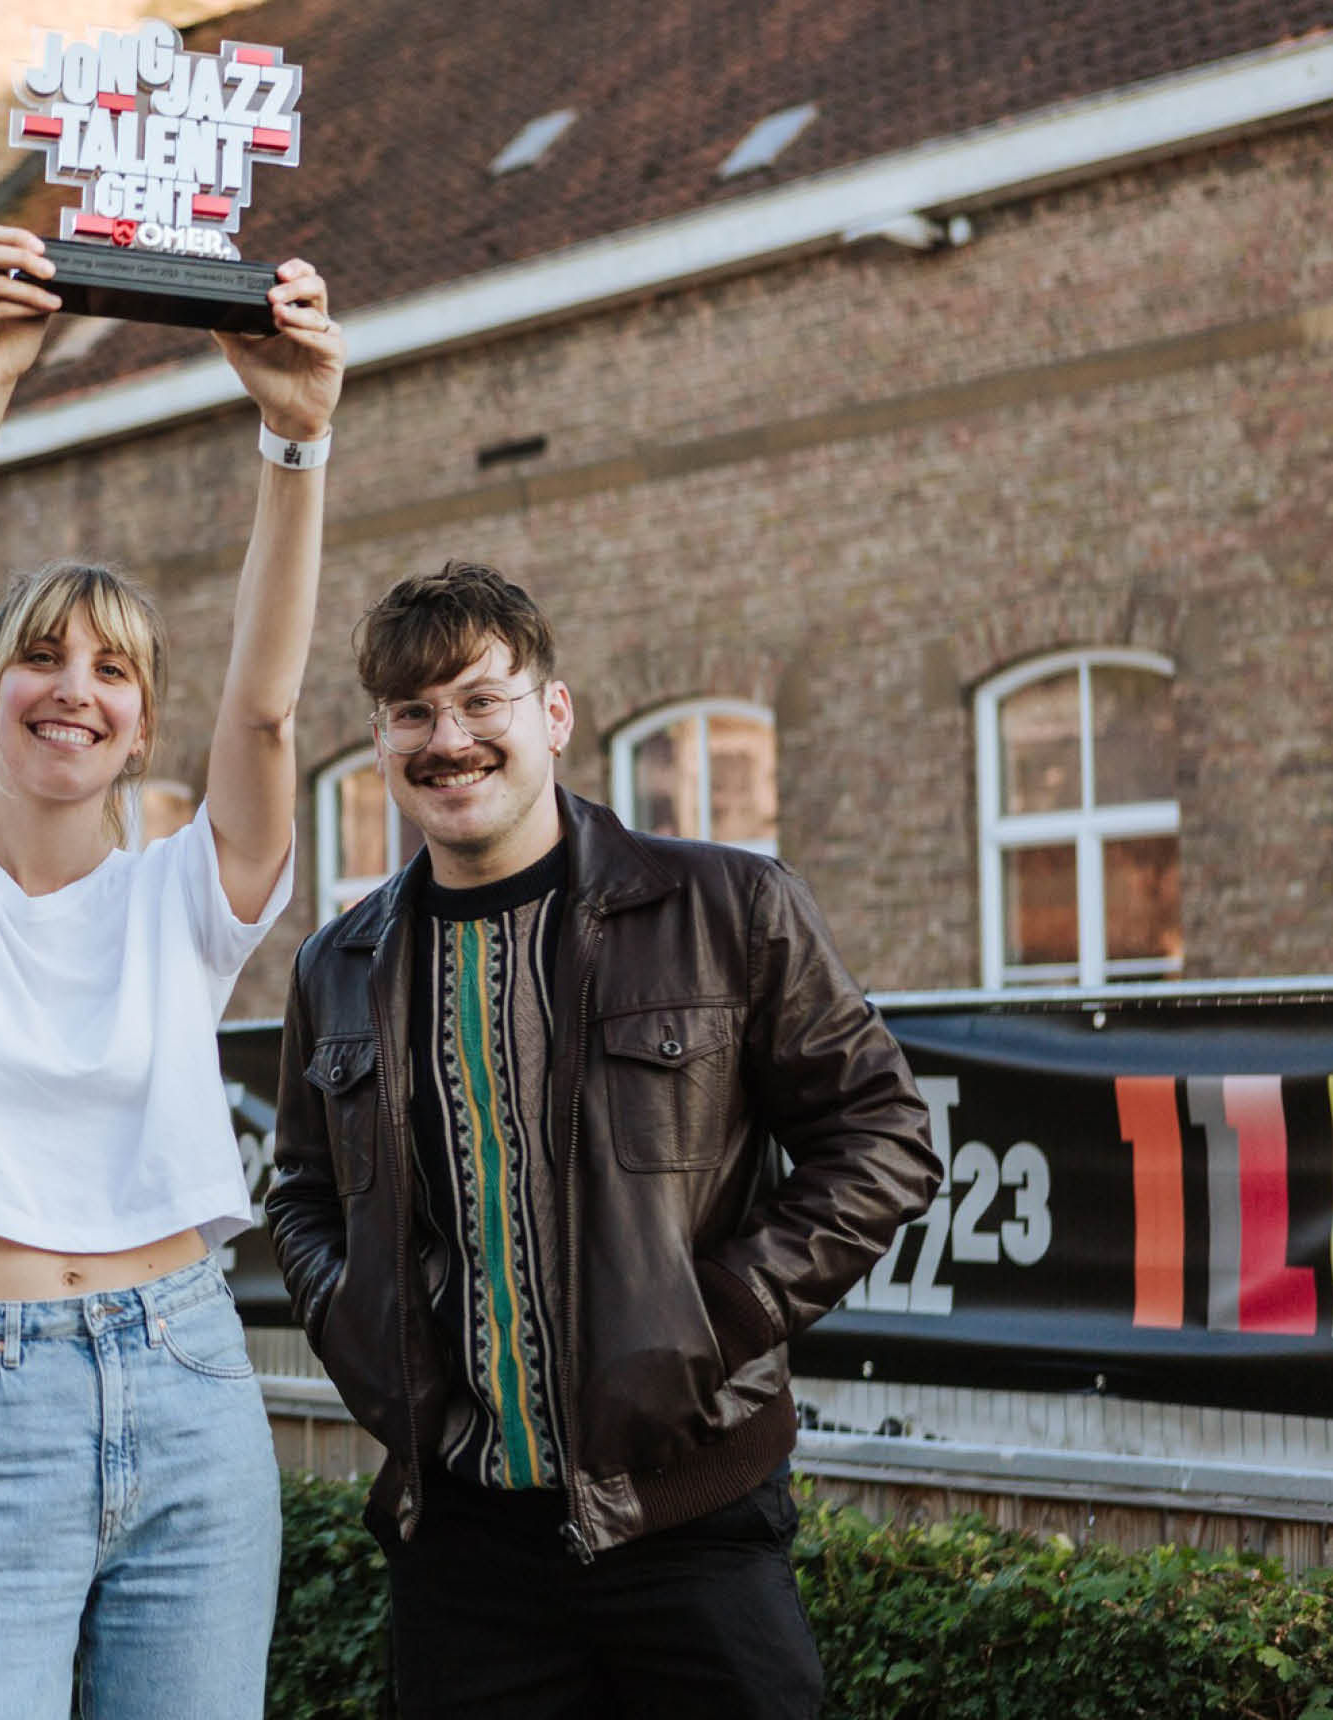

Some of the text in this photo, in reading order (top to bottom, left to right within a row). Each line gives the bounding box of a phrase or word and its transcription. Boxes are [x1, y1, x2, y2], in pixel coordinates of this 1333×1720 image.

[25, 18, 176, 105] JONG
[150, 55, 298, 131] JAZZ
[50, 101, 254, 192] TALENT
[93, 171, 200, 227] GENT
[951, 1141, 1052, 1267] 23
